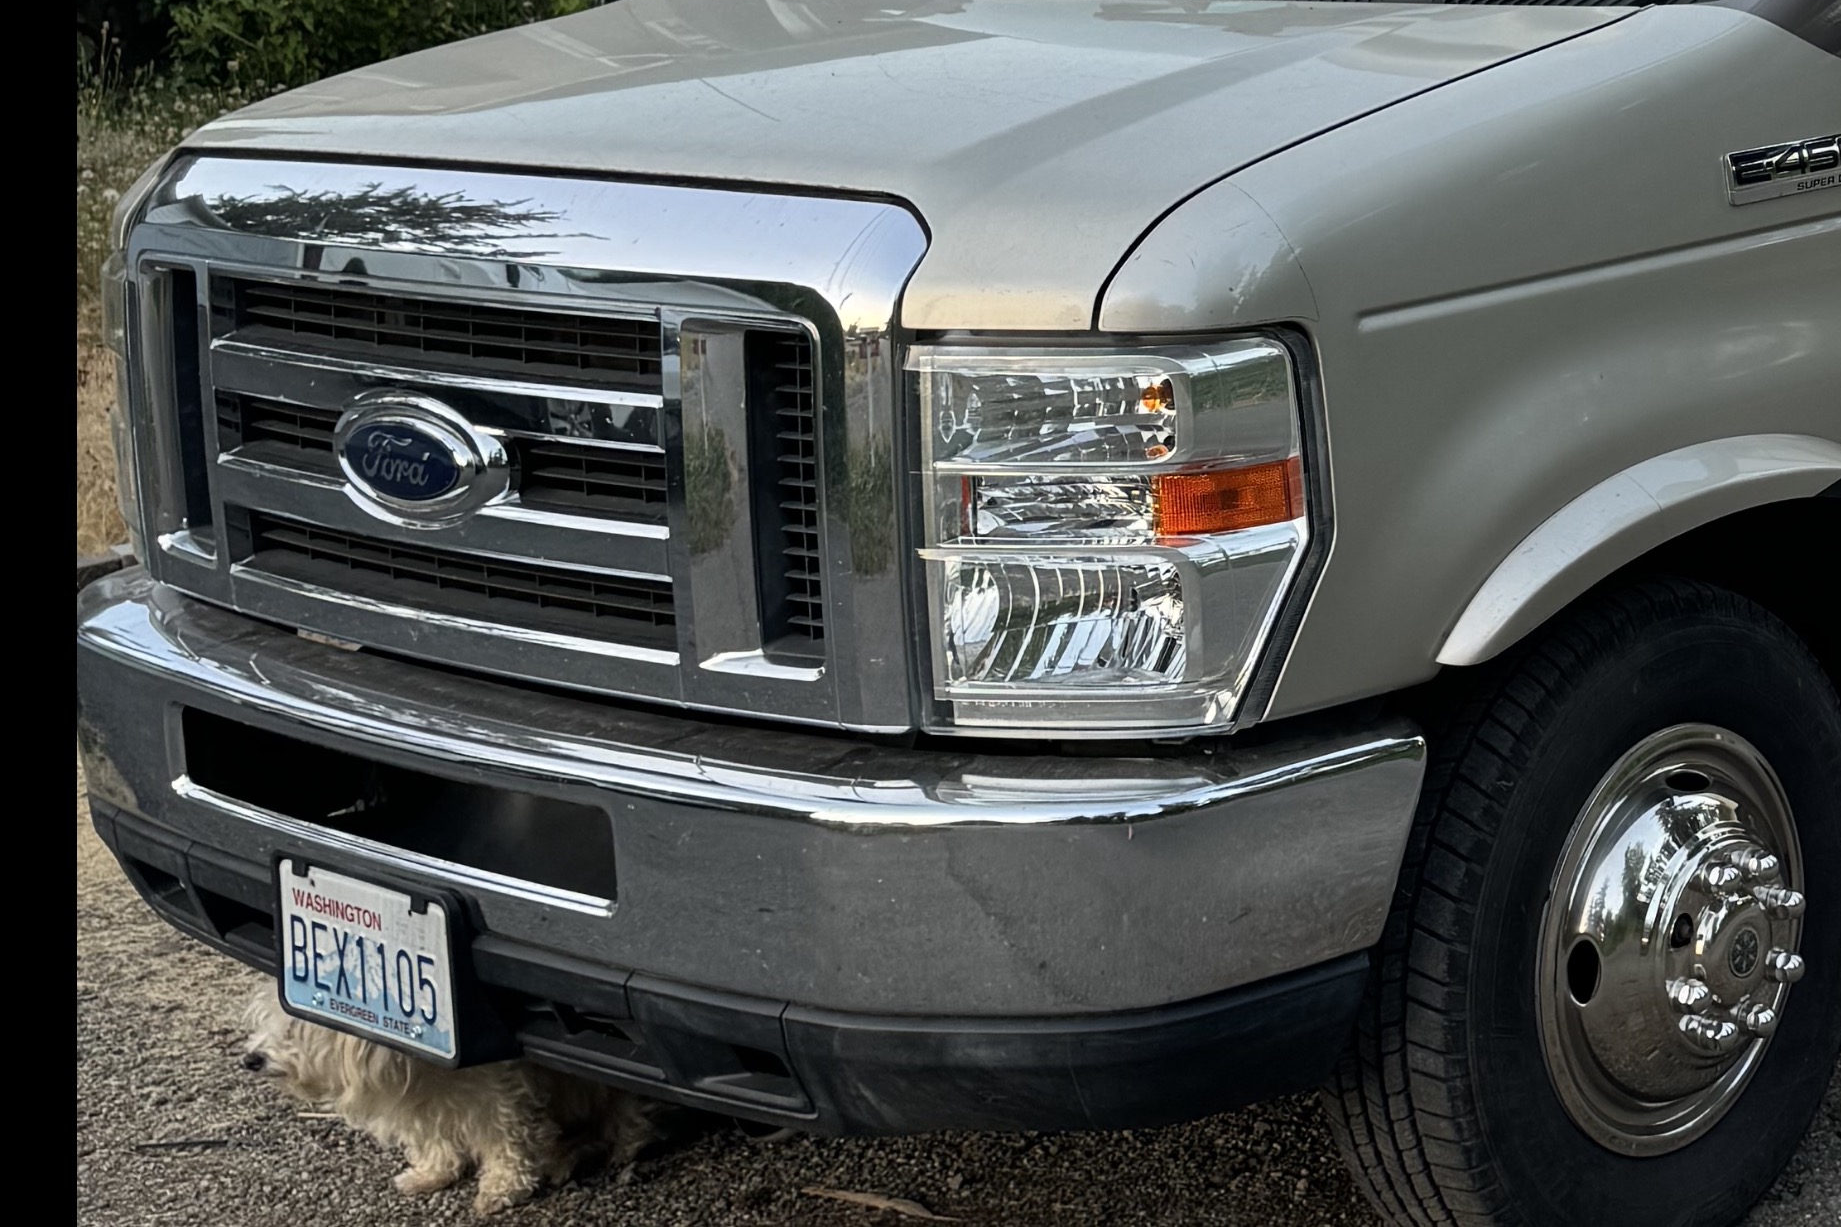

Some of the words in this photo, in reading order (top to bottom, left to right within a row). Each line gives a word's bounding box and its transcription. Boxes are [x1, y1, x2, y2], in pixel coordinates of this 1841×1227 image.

[1797, 175, 1835, 191] SUPER
[362, 430, 430, 486] Ford
[292, 887, 383, 931] WASHINGTON
[290, 913, 438, 1025] BEX1105
[329, 998, 380, 1025] EVERGREEN
[383, 1015, 411, 1036] STATE
